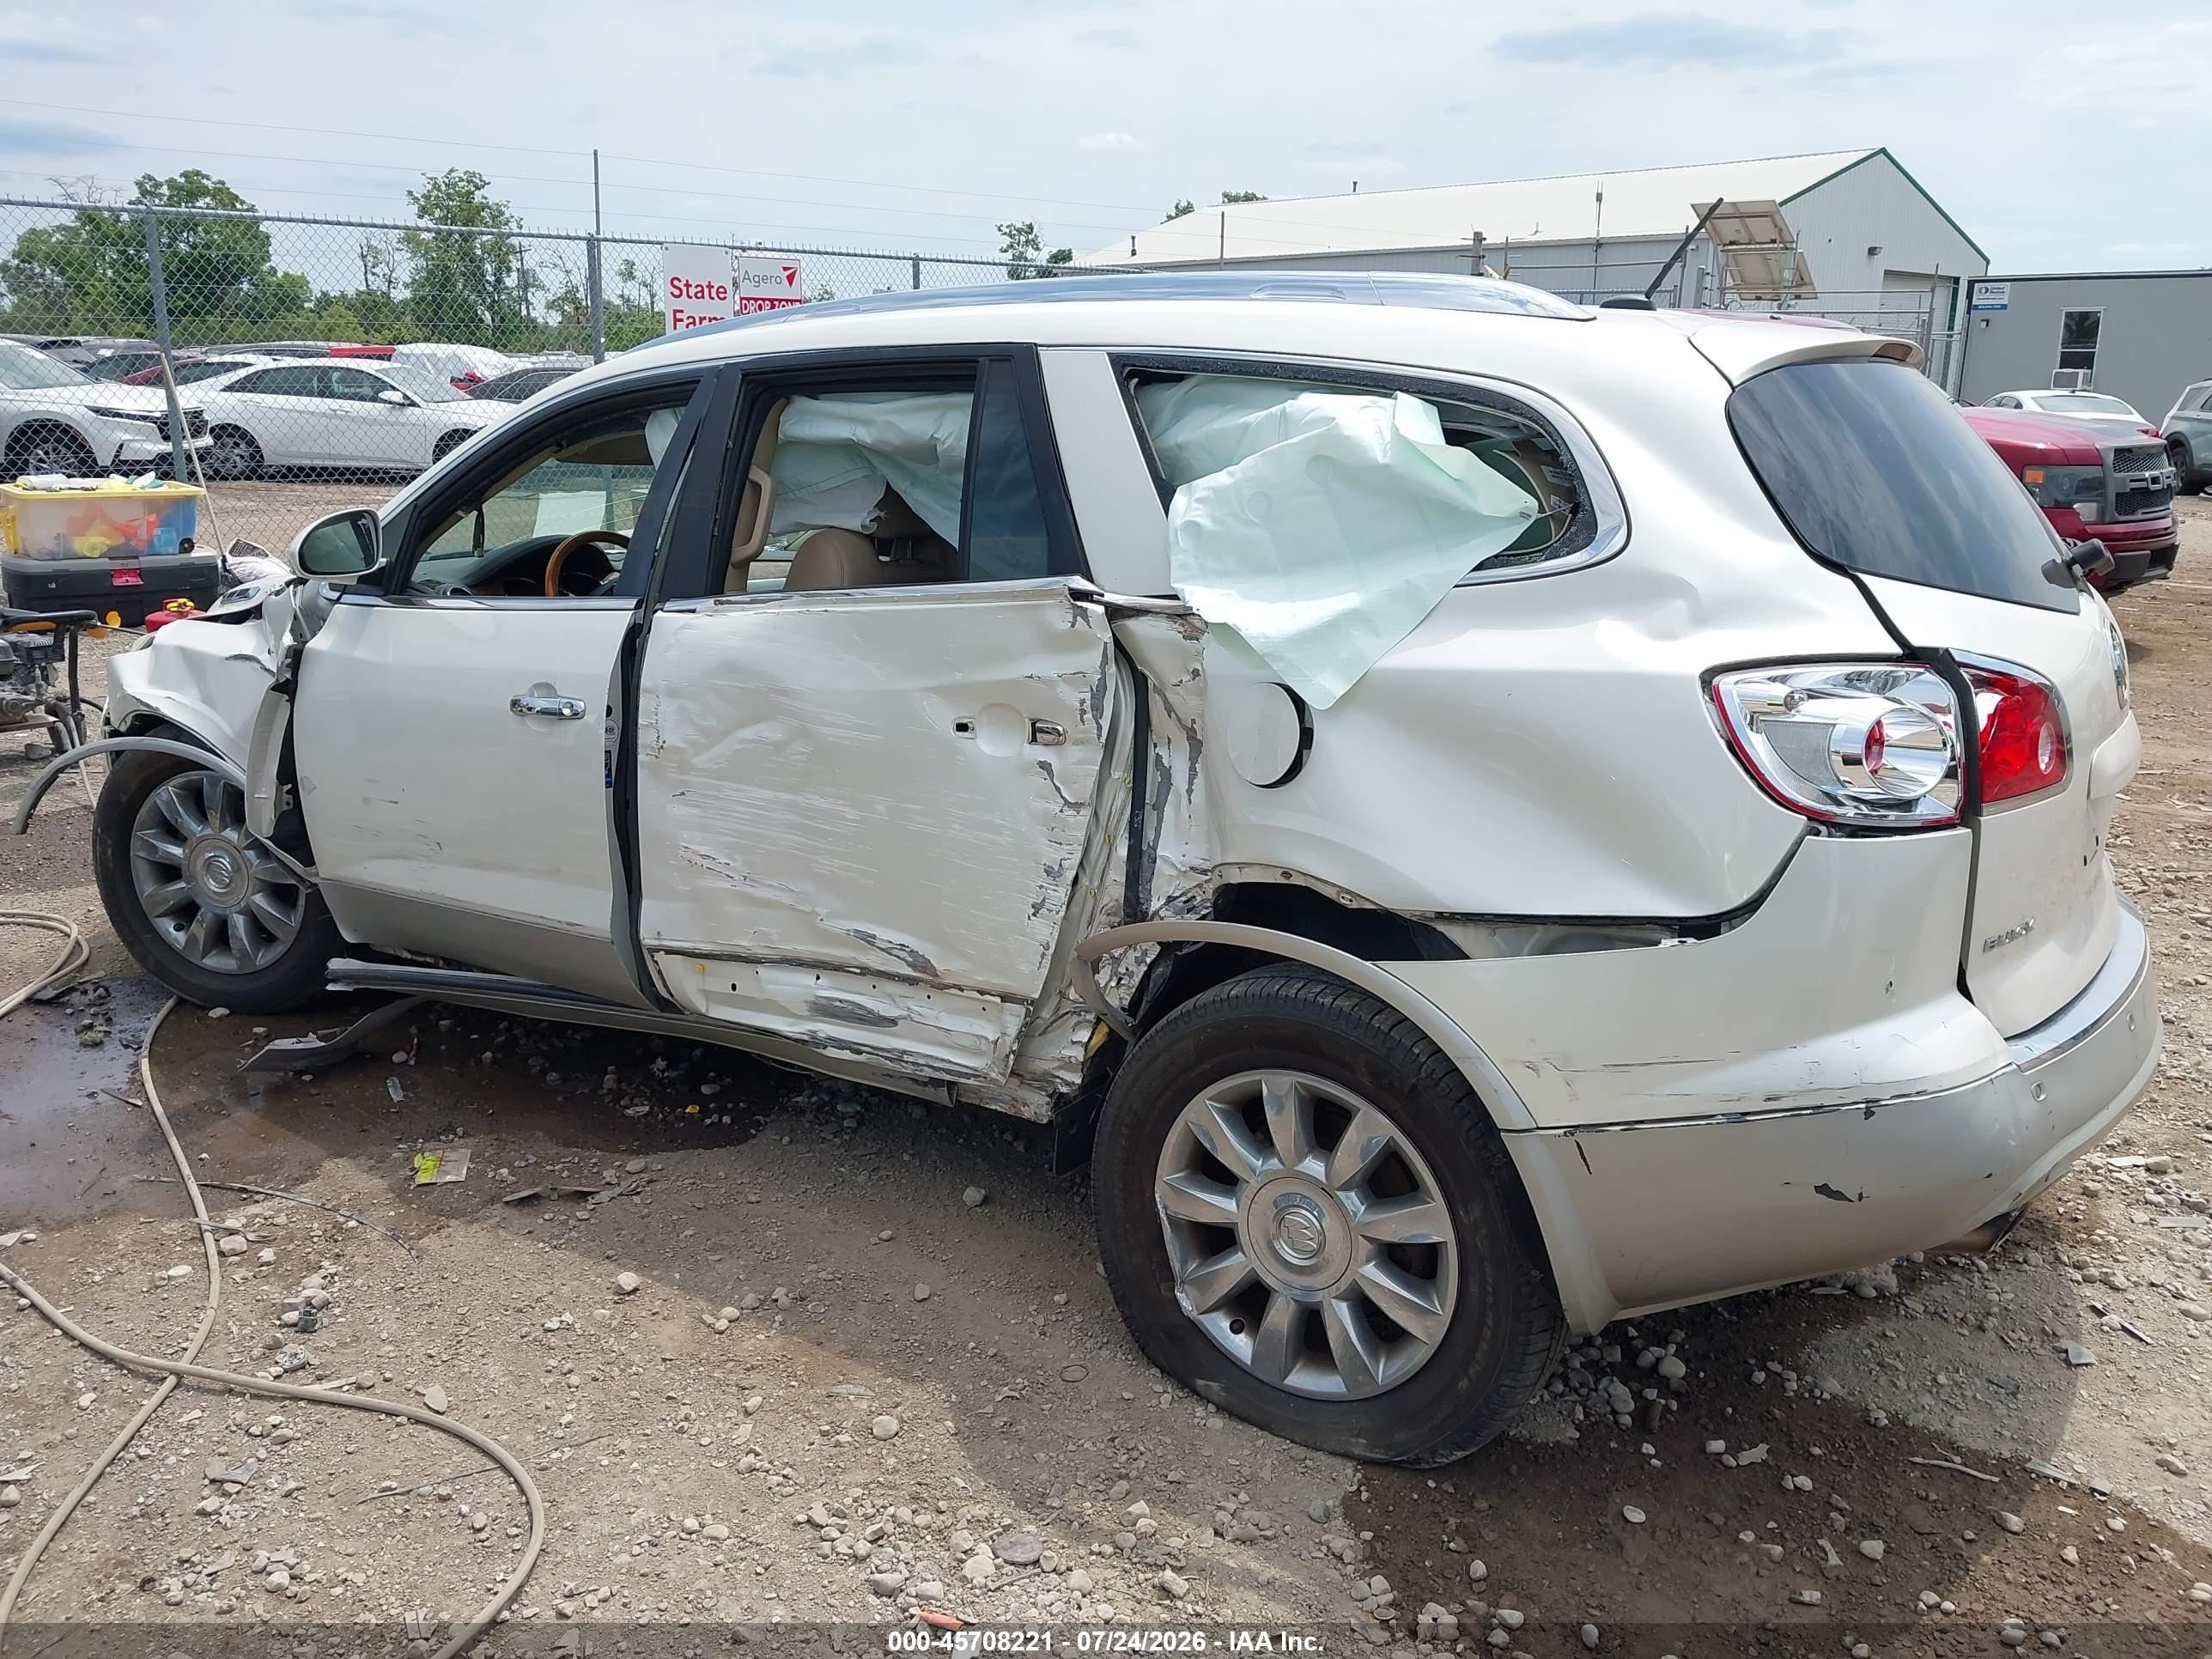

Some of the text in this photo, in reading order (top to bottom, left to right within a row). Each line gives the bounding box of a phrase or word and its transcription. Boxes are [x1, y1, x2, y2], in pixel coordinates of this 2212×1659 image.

[742, 270, 782, 288] Agero
[670, 276, 727, 301] State
[741, 300, 771, 314] DROP
